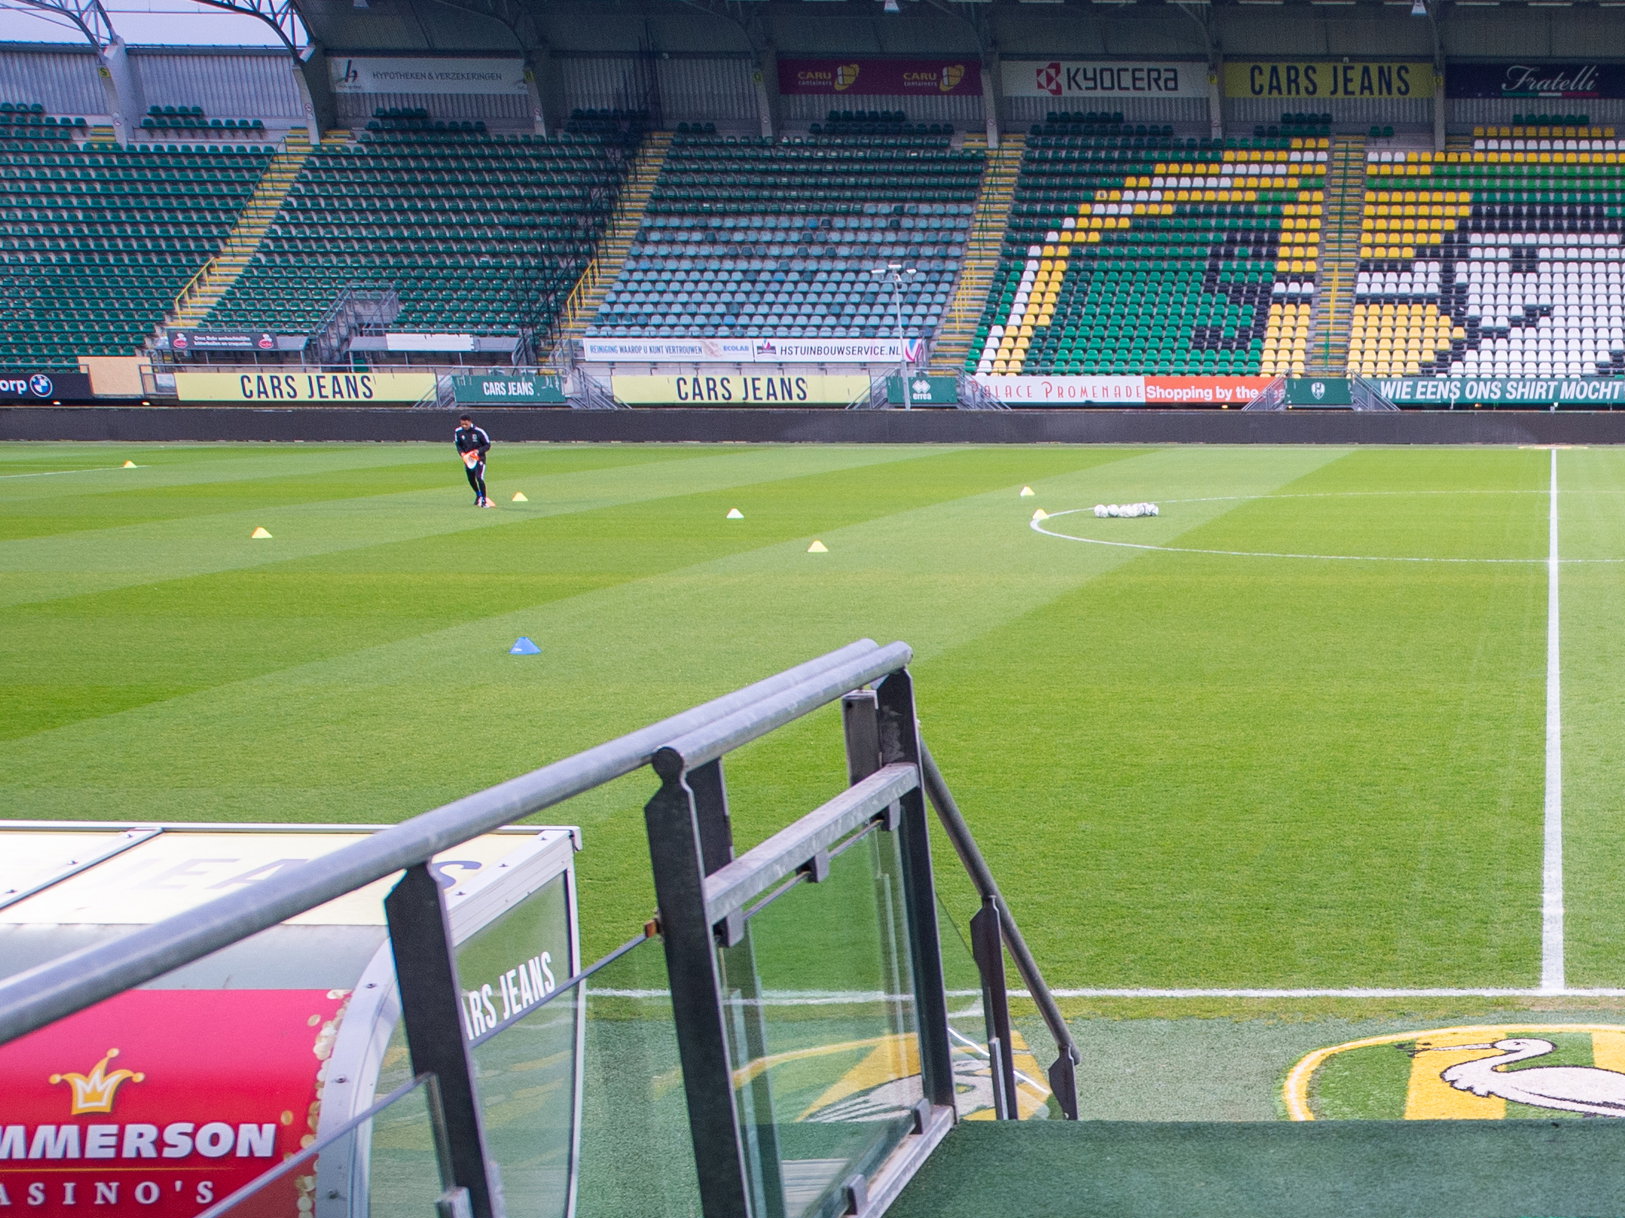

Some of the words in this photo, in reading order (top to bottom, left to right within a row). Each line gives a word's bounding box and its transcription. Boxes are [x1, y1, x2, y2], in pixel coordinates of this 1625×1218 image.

[373, 71, 427, 80] HYPOTHEKEN
[434, 72, 502, 81] VERZEKERINGEN
[797, 71, 831, 80] CARU
[903, 72, 937, 80] CARU
[1066, 67, 1178, 91] KYOCERA
[1250, 65, 1317, 96] CARS
[1330, 65, 1410, 96] JEANS
[1501, 65, 1599, 91] Fratelli
[619, 345, 642, 354] WAAROP
[649, 346, 664, 354] KUNT
[664, 345, 702, 355] VERTROUWEN
[780, 346, 901, 356] HSTUINBOUWSERVICE.NL
[0, 379, 27, 394] orp
[240, 375, 298, 399] CARS
[307, 375, 373, 399] JEANS
[483, 382, 506, 396] CARS
[508, 381, 534, 396] JEANS
[676, 377, 732, 401] CARS
[742, 377, 807, 401] JEANS
[1041, 381, 1142, 399] PROMENADE
[1146, 386, 1213, 401] Shopping
[1215, 386, 1232, 401] by
[1235, 386, 1259, 398] the
[1380, 381, 1413, 399] WIE
[1415, 381, 1461, 399] EENS
[1465, 381, 1501, 399] ONS
[1505, 381, 1558, 399] SHIRT
[499, 951, 556, 1020] JEANS
